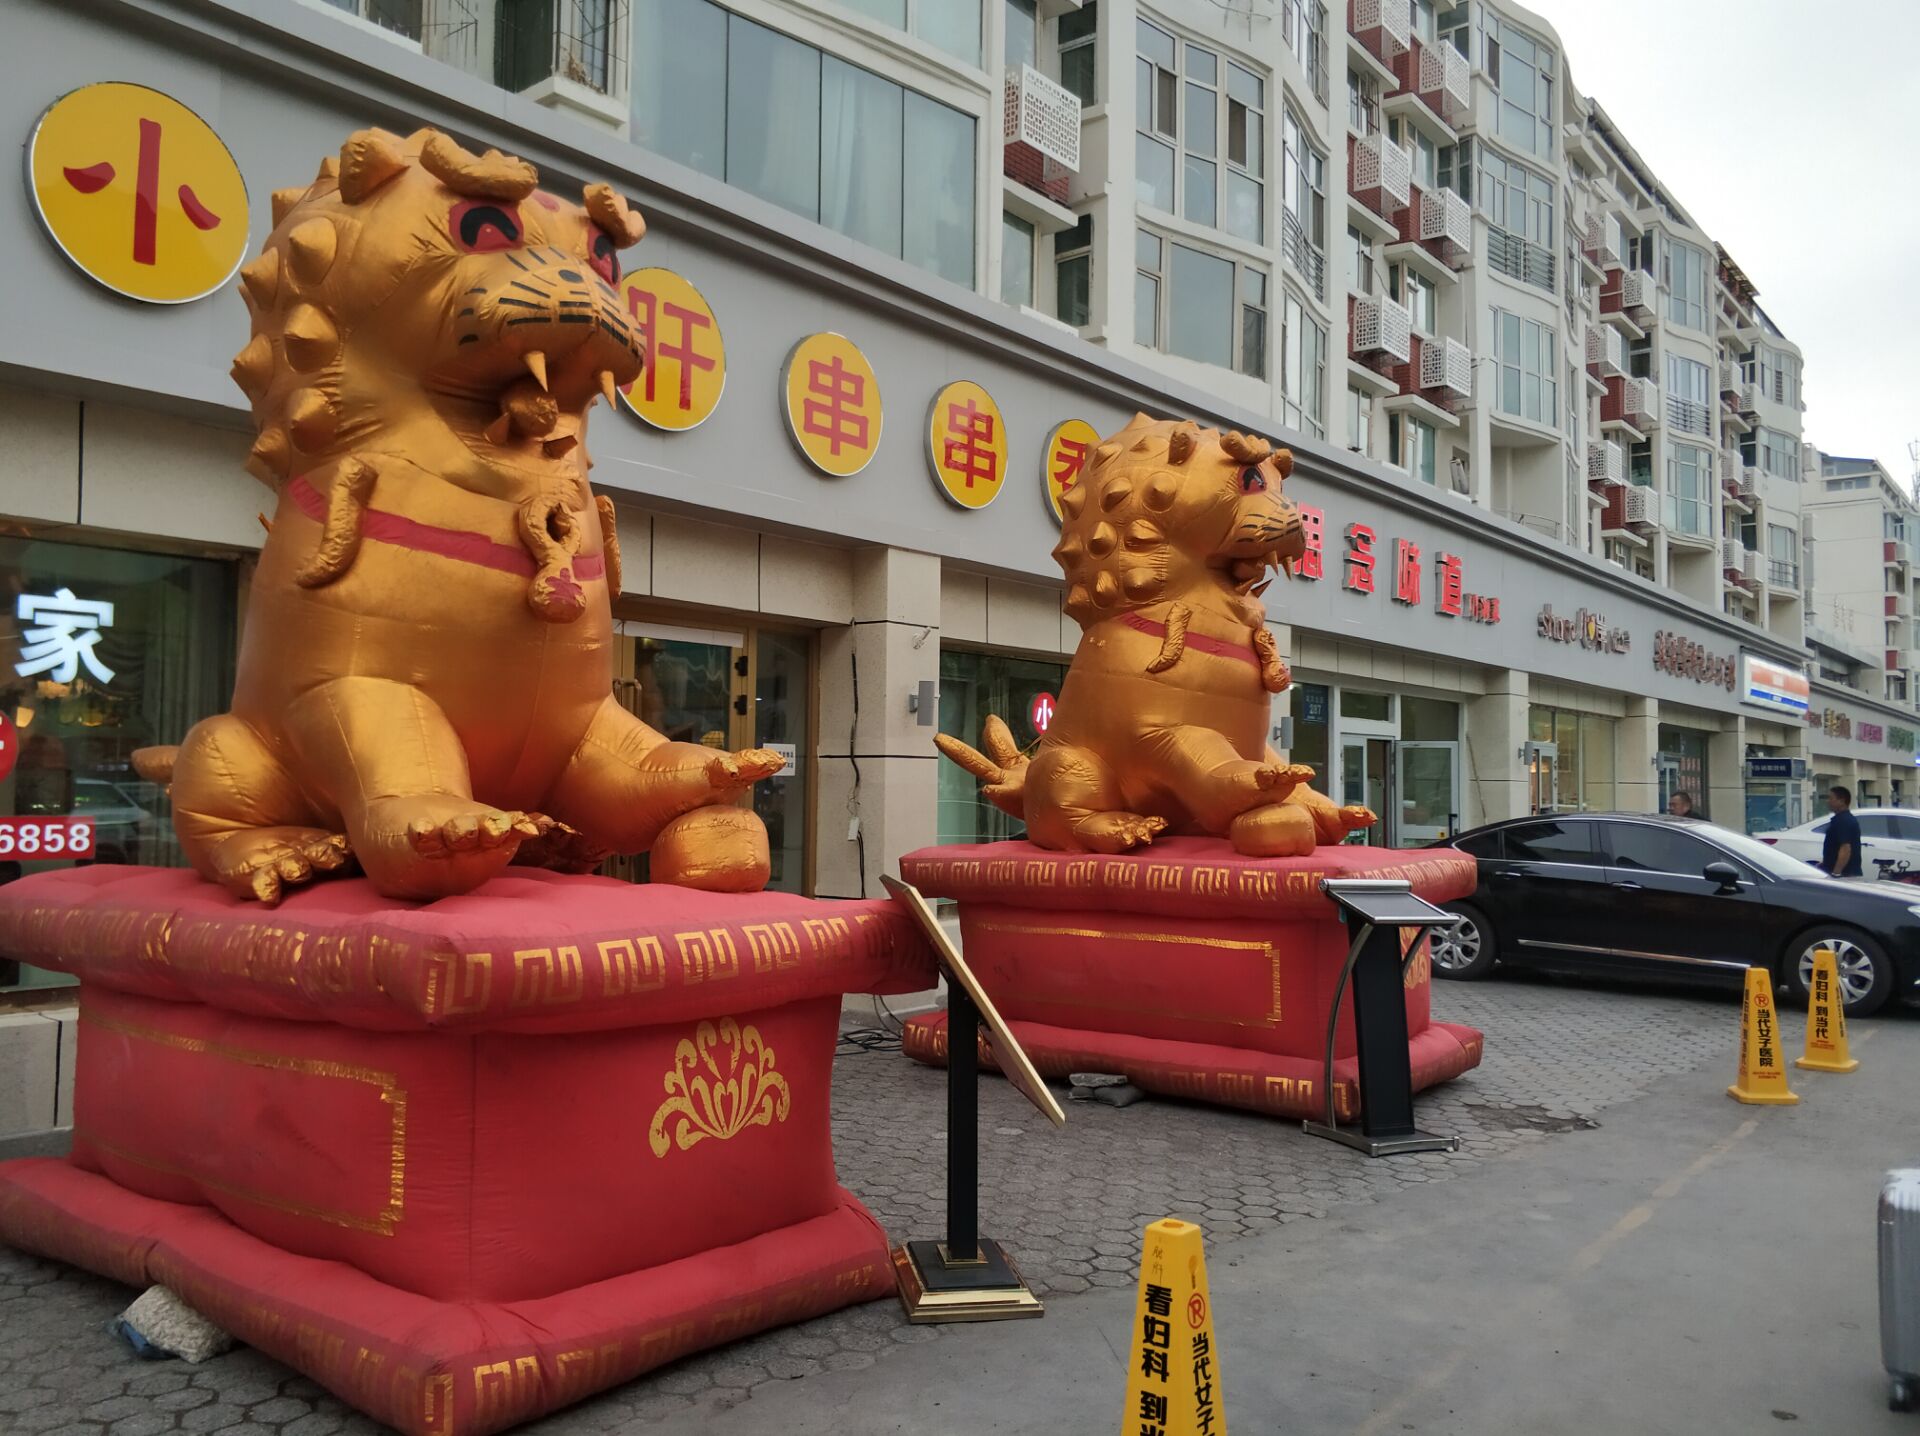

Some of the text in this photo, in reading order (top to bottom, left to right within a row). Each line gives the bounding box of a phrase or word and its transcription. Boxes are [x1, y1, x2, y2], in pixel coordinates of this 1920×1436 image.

[62, 117, 221, 266] 小
[14, 587, 116, 685] 家
[1035, 698, 1054, 731] 小
[0, 823, 91, 854] 6858
[1757, 1008, 1774, 1068] 当代女子医院
[1141, 1283, 1173, 1383] 看妇科
[1192, 1331, 1216, 1436] 当代女子
